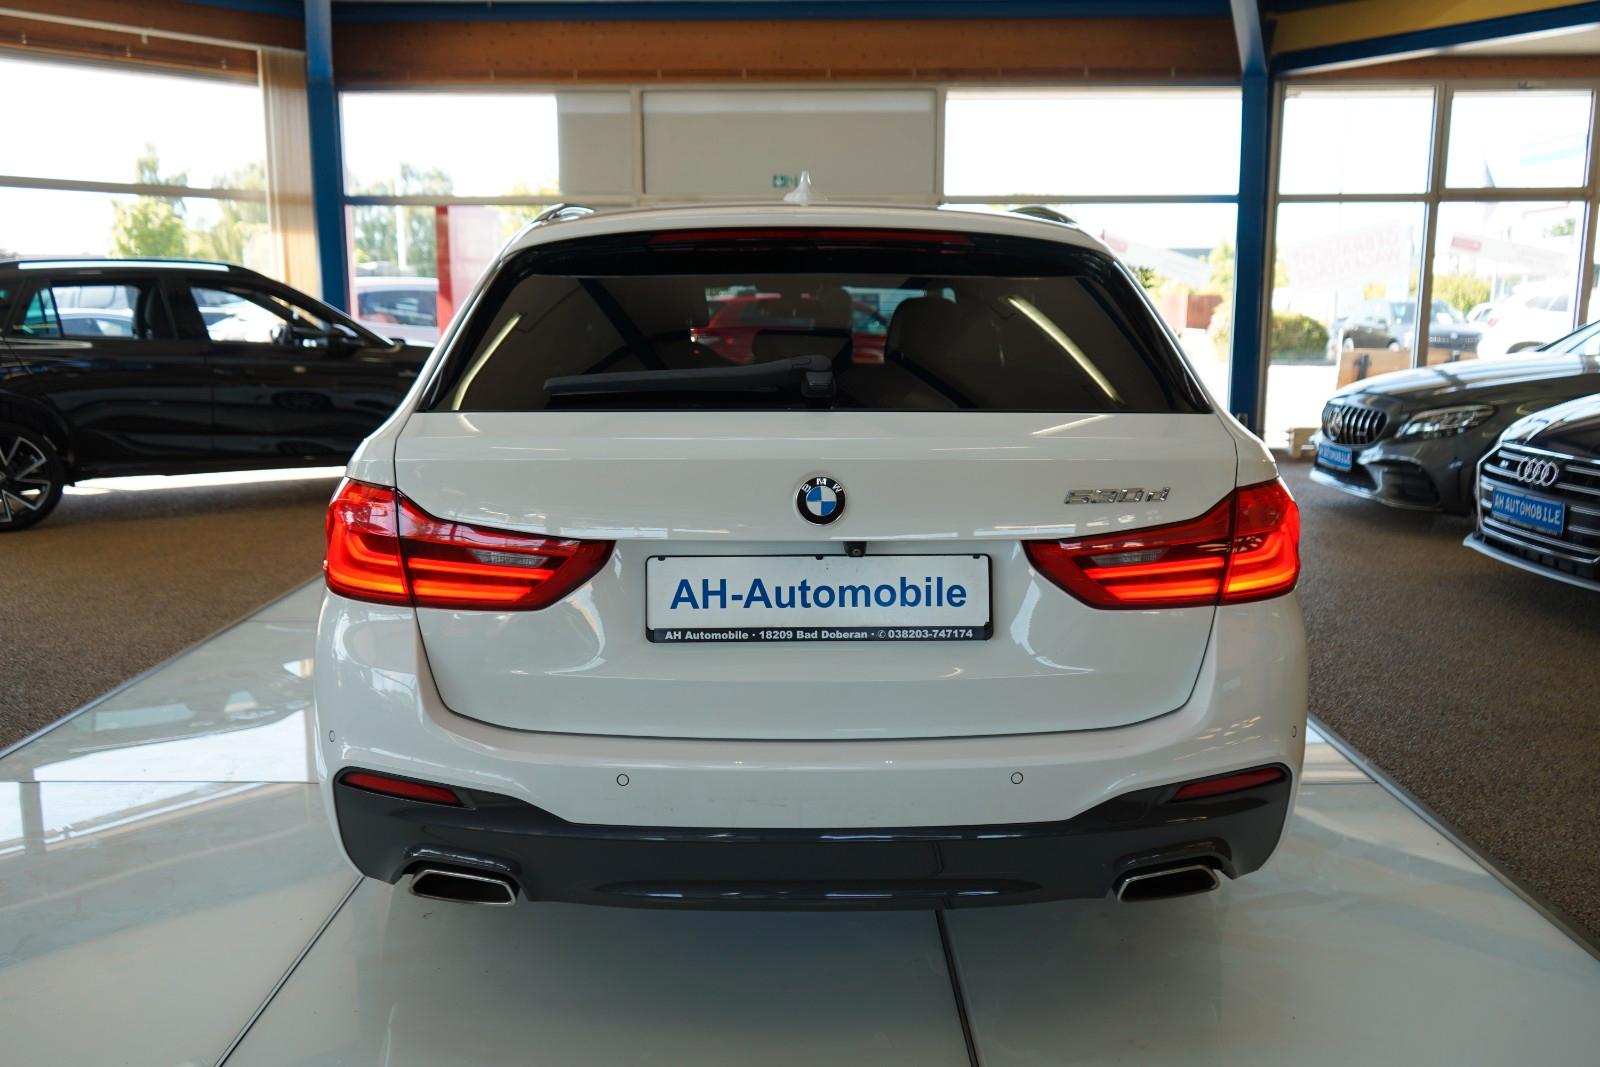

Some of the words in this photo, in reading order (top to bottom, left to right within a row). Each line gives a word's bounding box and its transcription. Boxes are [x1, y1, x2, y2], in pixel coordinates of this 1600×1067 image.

[1064, 487, 1171, 504] 530d
[1494, 493, 1504, 509] AH
[1505, 496, 1561, 525] AUTOMOBILE
[670, 576, 967, 610] AH-Automobile
[665, 631, 681, 640] AH
[684, 630, 749, 640] Automobile
[759, 630, 793, 639] 18209
[796, 630, 818, 639] Bad
[821, 630, 868, 639] Doberan
[887, 629, 973, 639] 038203-747174
